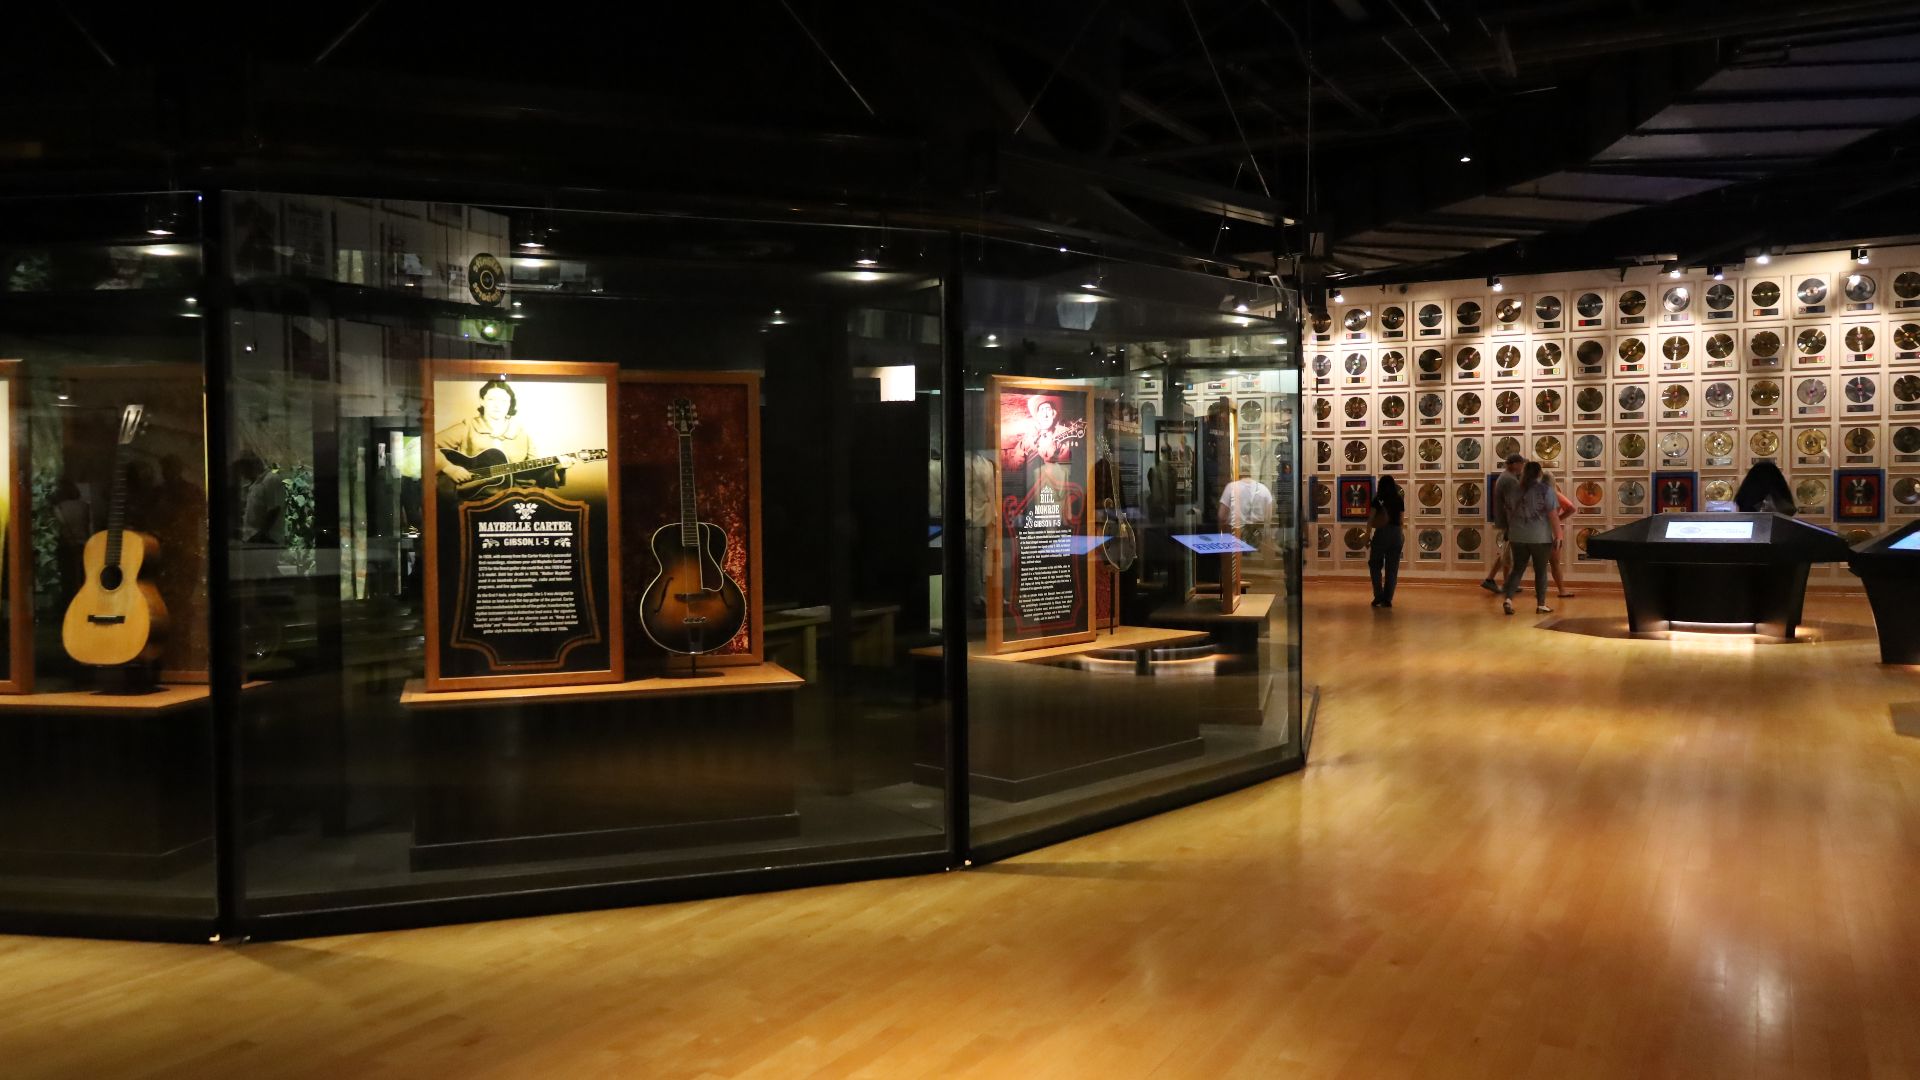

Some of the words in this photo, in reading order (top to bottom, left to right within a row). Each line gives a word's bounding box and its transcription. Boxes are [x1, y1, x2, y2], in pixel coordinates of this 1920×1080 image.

[1040, 494, 1054, 503] BILL
[1034, 505, 1059, 514] MONROE
[478, 522, 531, 532] MAYBELLE
[533, 521, 572, 531] CARTER
[535, 537, 549, 545] L-5
